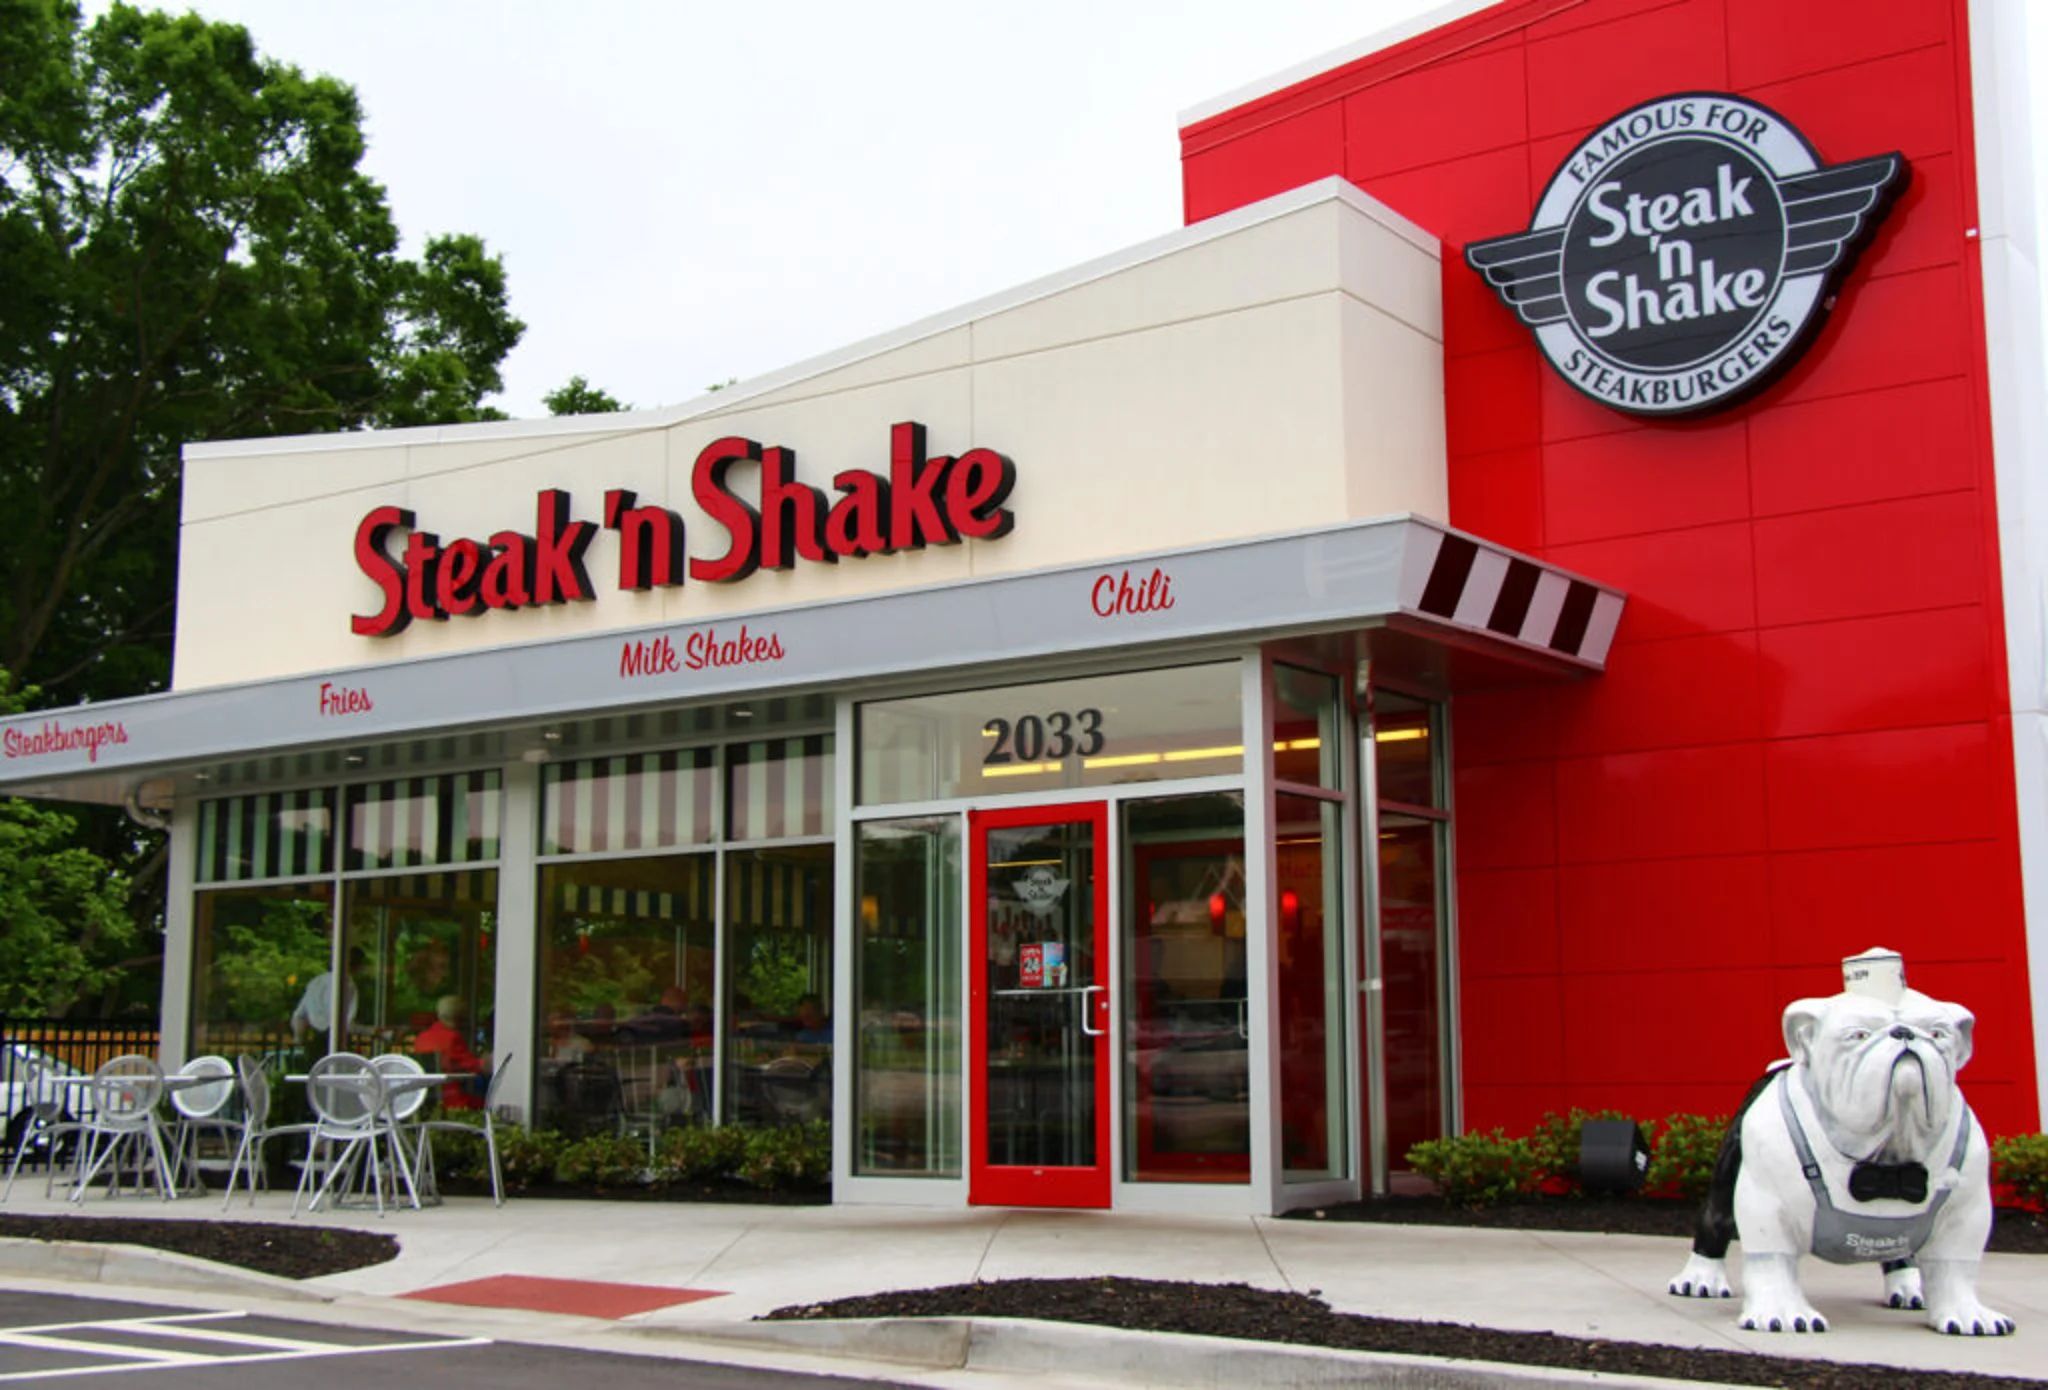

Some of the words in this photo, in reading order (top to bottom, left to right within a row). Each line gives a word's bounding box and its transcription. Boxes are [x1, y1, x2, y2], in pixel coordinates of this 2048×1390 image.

[1566, 103, 1696, 184] FAMOUS
[1704, 103, 1769, 146] FOR
[1587, 163, 1755, 248] Steak
[1649, 233, 1693, 282] 'n
[1585, 259, 1767, 338] Shake
[1564, 313, 1792, 405] STEAKBURGERS
[351, 487, 597, 638] Steak
[603, 488, 686, 592] 'n
[689, 420, 1016, 584] Shake
[1091, 567, 1175, 618] Chili
[619, 631, 681, 678] Milk
[685, 624, 786, 671] Shakes
[319, 681, 374, 716] Fries
[2, 719, 129, 763] Steakburgers
[982, 707, 1106, 765] 2033
